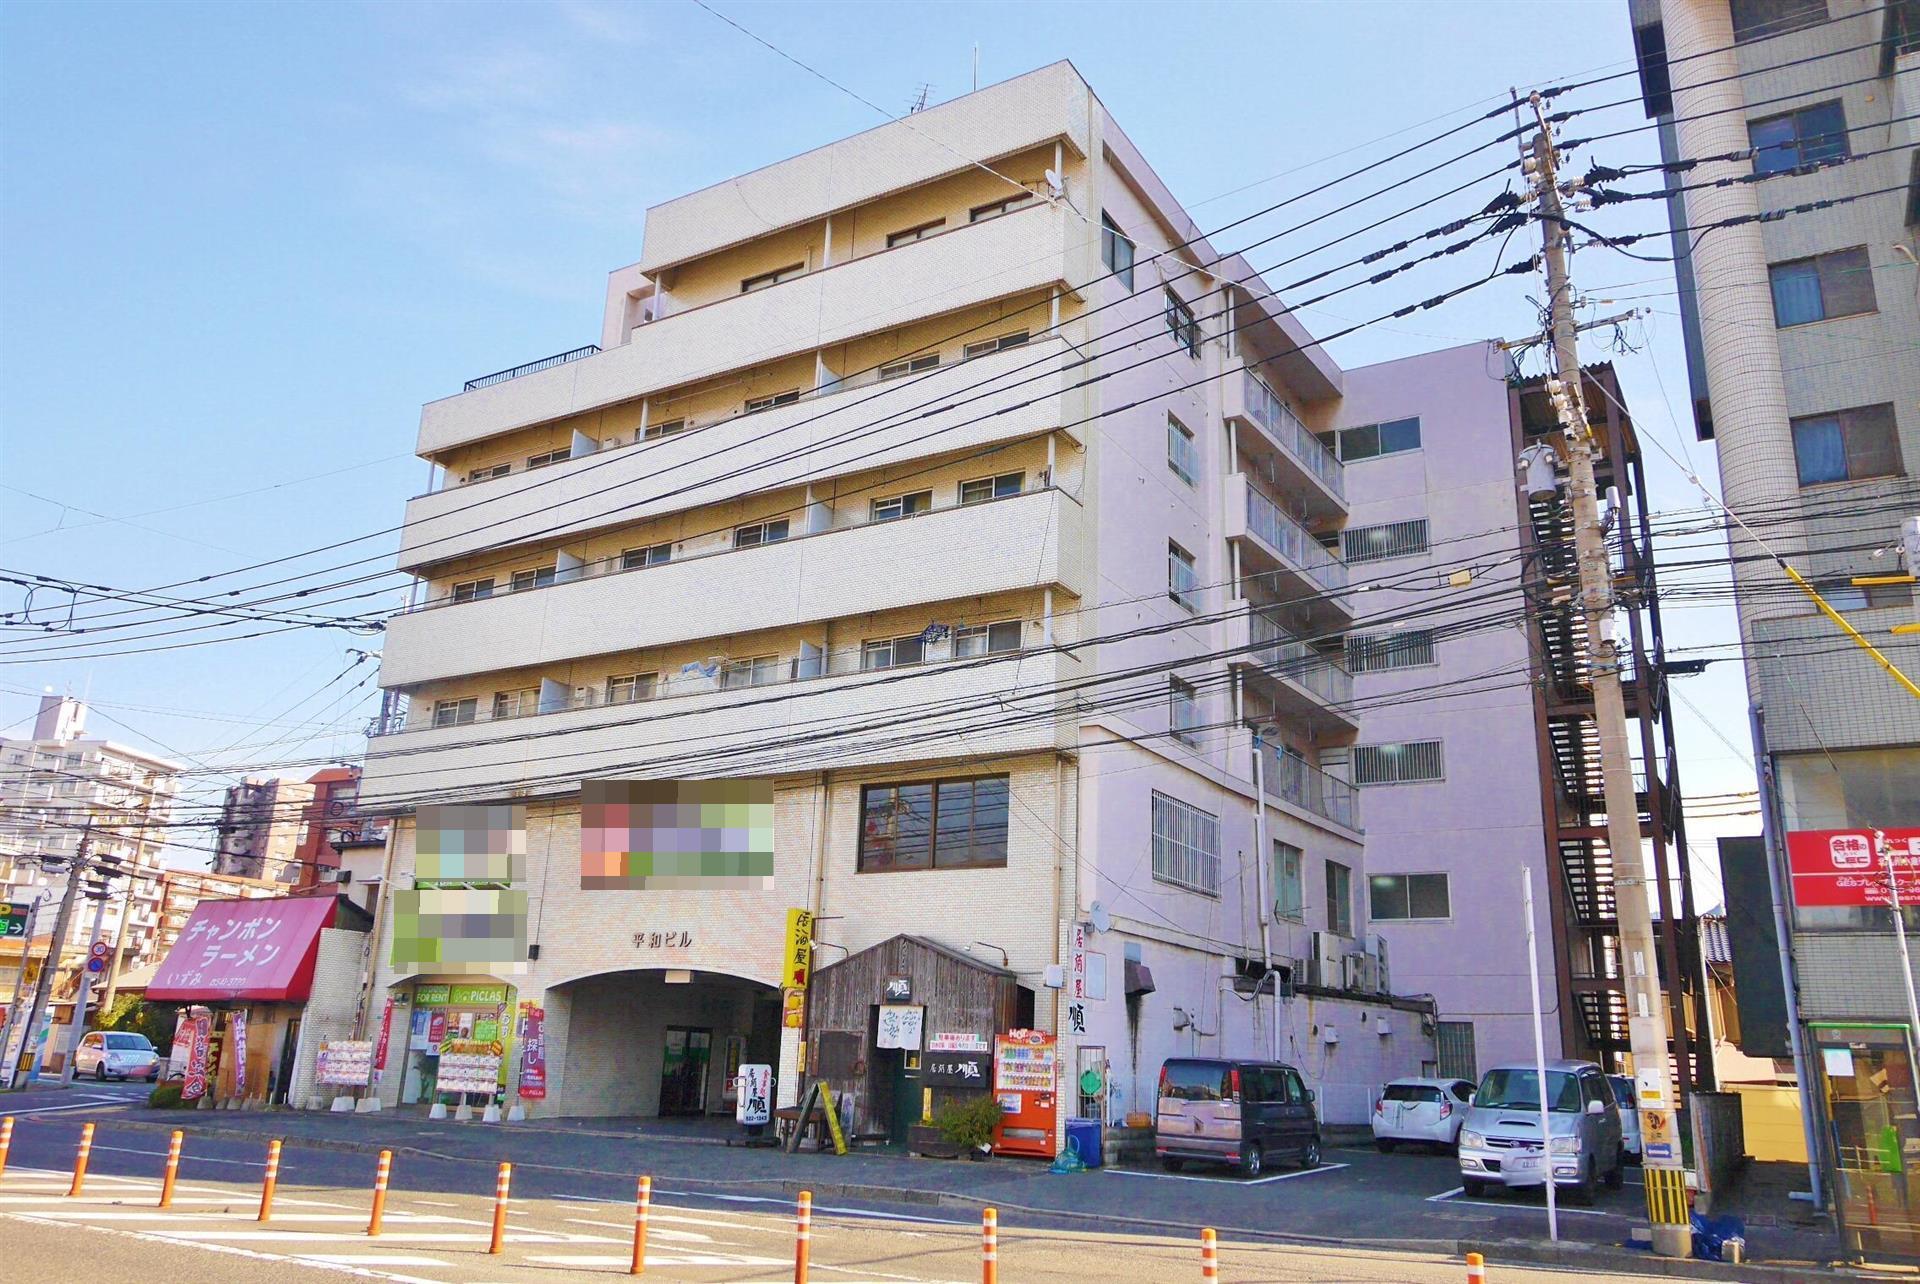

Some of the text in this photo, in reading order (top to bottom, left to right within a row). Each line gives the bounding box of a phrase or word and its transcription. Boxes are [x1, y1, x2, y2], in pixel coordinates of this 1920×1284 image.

[1832, 839, 1867, 851] 合格の
[1834, 856, 1868, 864] LEC
[186, 918, 281, 941] チャンポン
[632, 931, 692, 948] 平和ビル
[200, 944, 280, 968] ラーメン
[167, 970, 202, 986] いずみ
[470, 990, 501, 1001] PICLAS
[886, 980, 910, 997] 順
[416, 993, 430, 1002] FOR
[747, 1096, 767, 1114] 順
